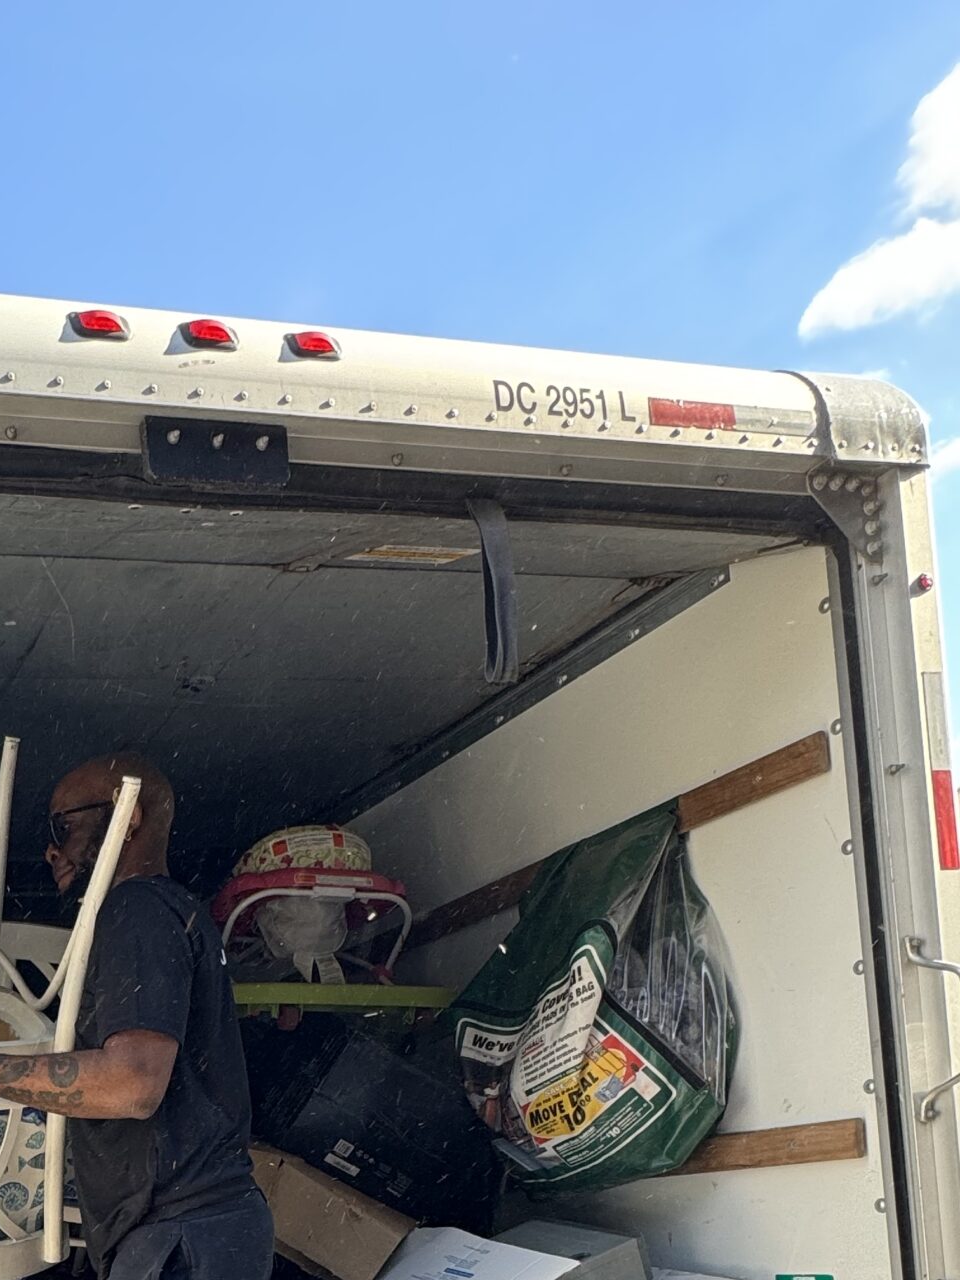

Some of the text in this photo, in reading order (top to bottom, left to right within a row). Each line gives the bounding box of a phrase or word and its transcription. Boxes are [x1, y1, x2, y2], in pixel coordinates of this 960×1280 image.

[493, 380, 636, 422] DC 2951 L
[575, 981, 595, 998] BAG
[471, 1034, 515, 1053] We've
[529, 1100, 566, 1128] MOVE
